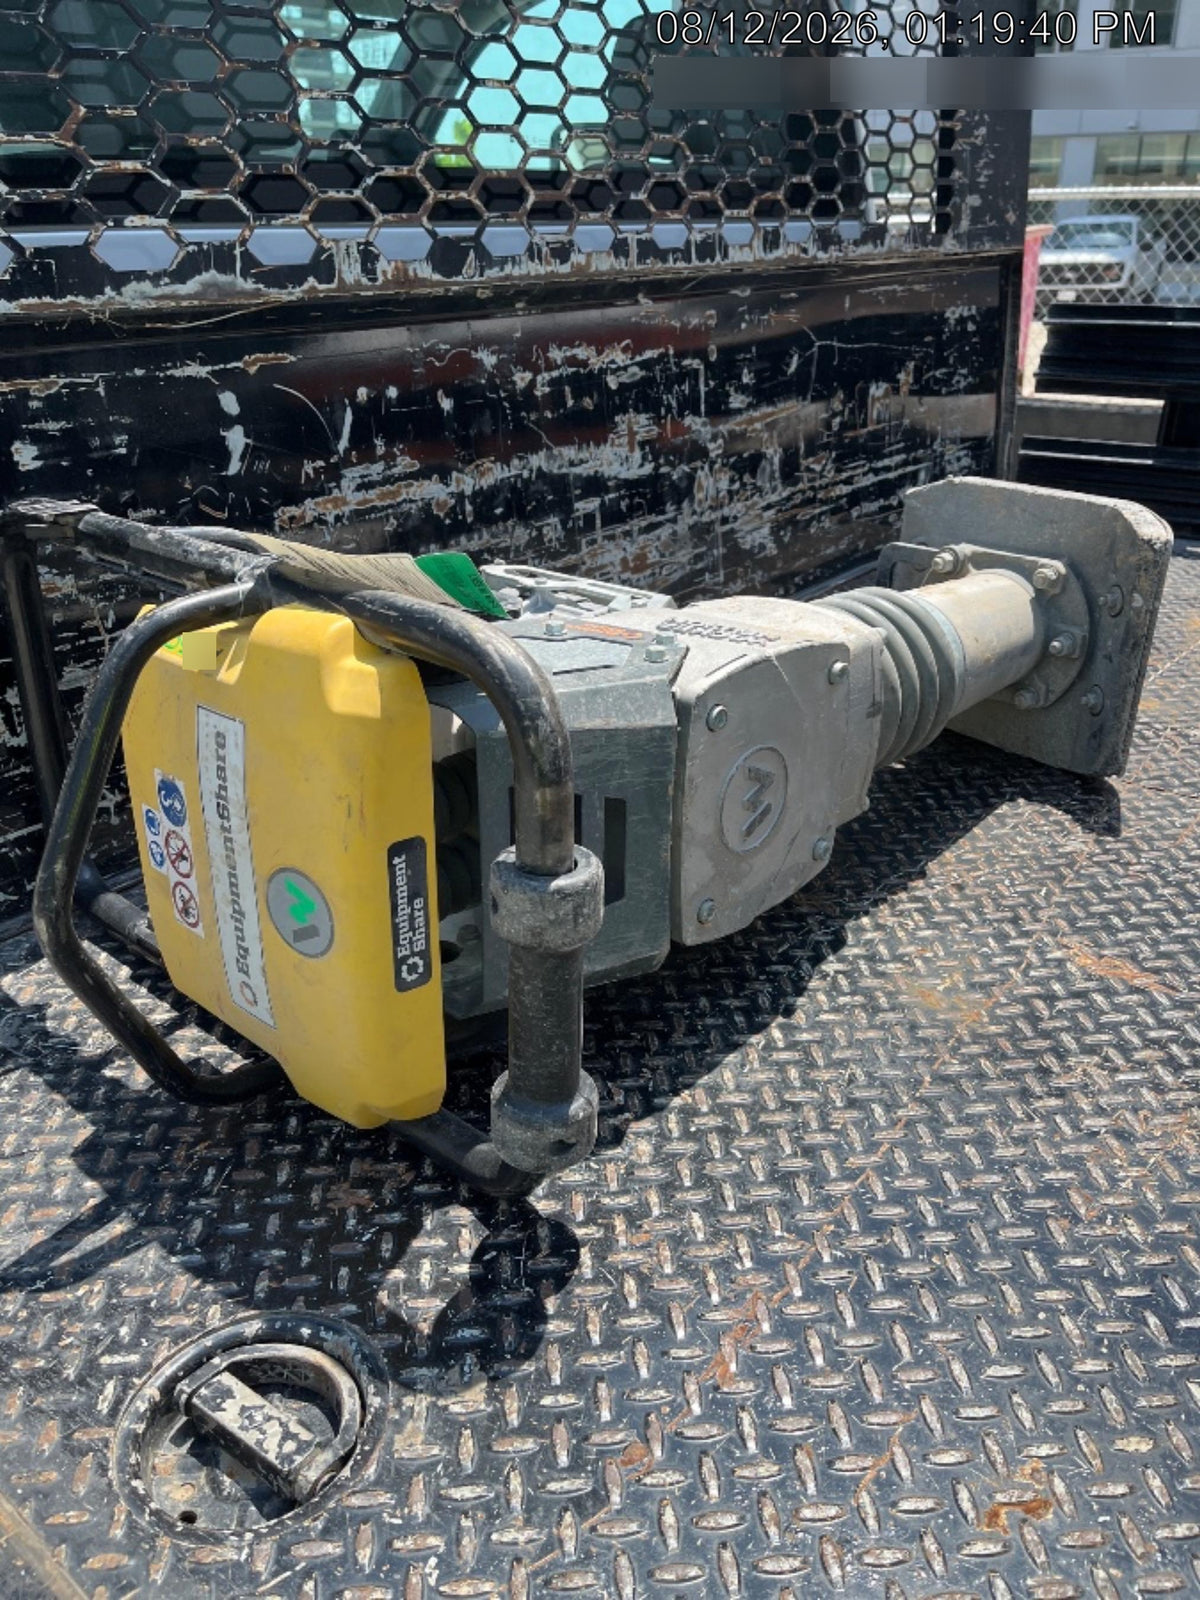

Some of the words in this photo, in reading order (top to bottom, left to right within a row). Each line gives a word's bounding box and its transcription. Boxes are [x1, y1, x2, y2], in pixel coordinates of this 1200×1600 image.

[214, 730, 251, 980] EquipmentShare
[392, 853, 413, 959] Equipment
[412, 897, 426, 953] Share
